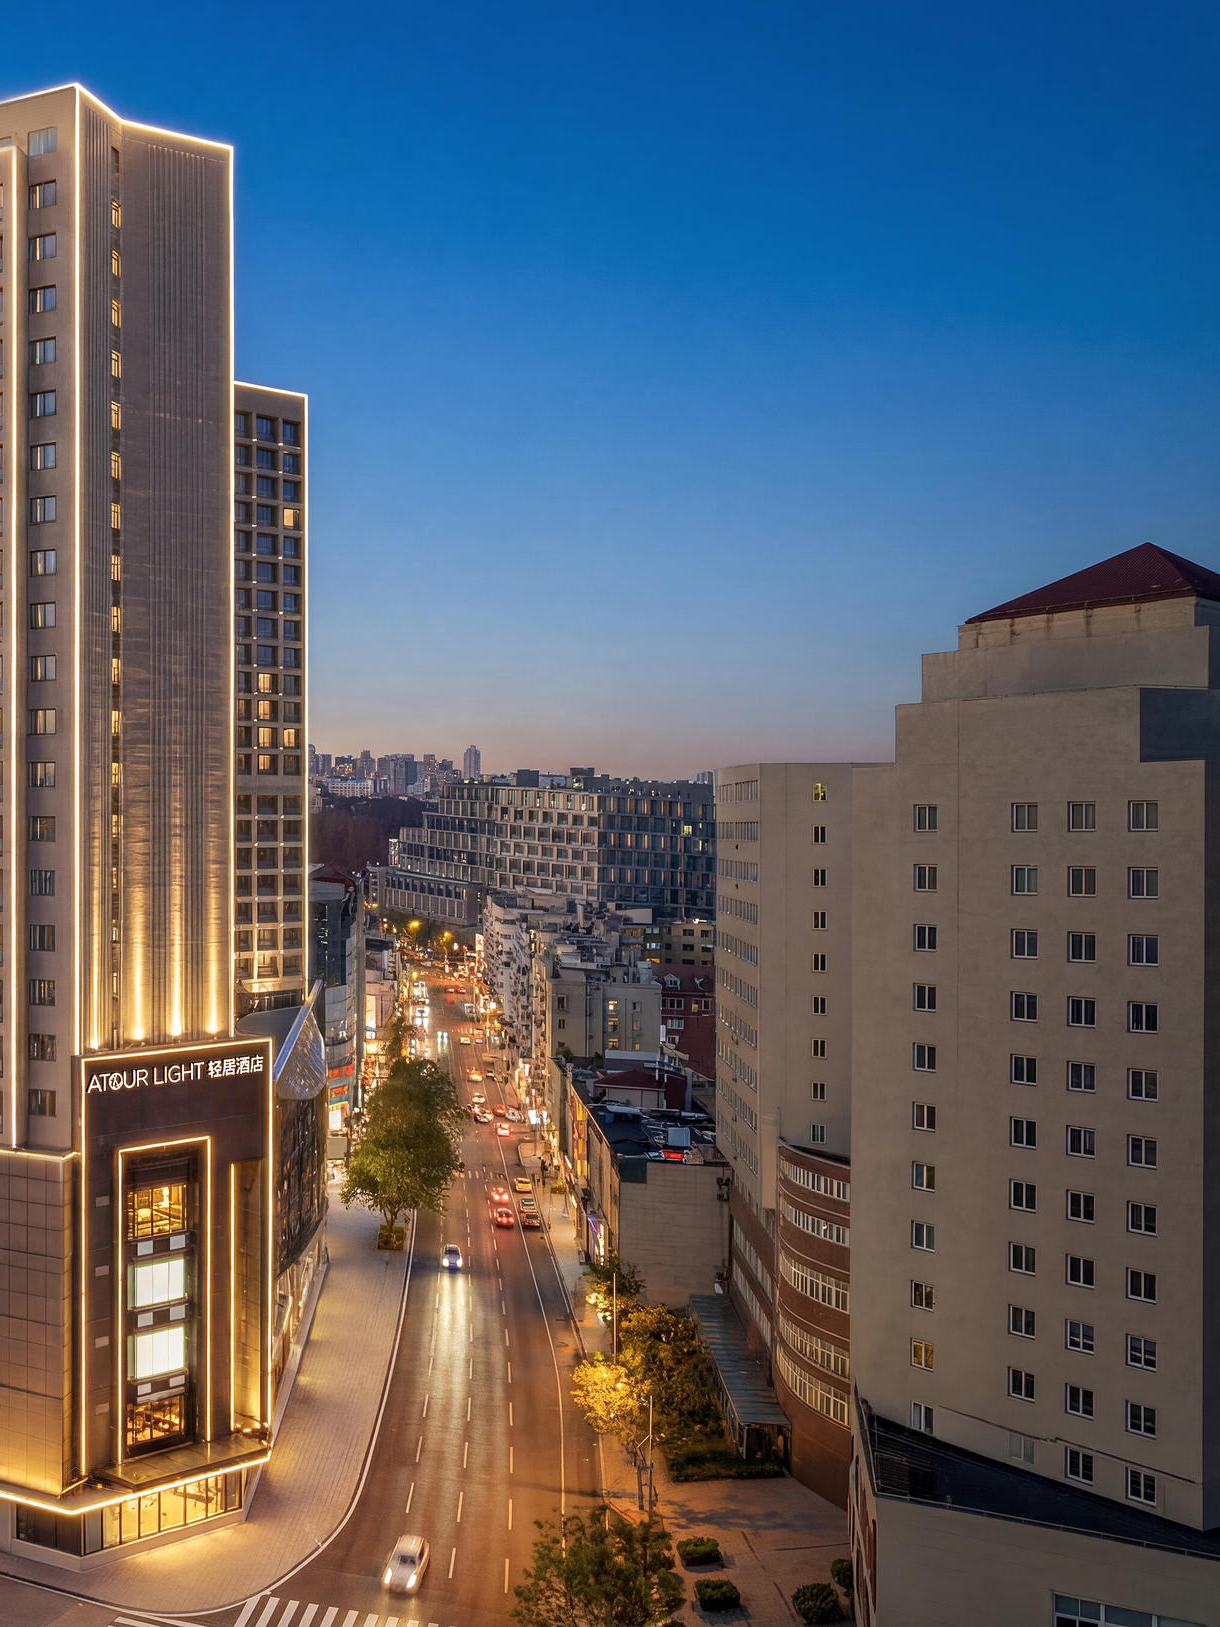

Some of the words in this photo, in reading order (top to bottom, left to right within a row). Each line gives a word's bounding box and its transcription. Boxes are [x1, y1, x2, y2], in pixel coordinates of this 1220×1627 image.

[87, 1068, 149, 1094] ATOUR
[153, 1061, 205, 1085] LIGHT
[208, 1054, 264, 1078] 轻居酒店
